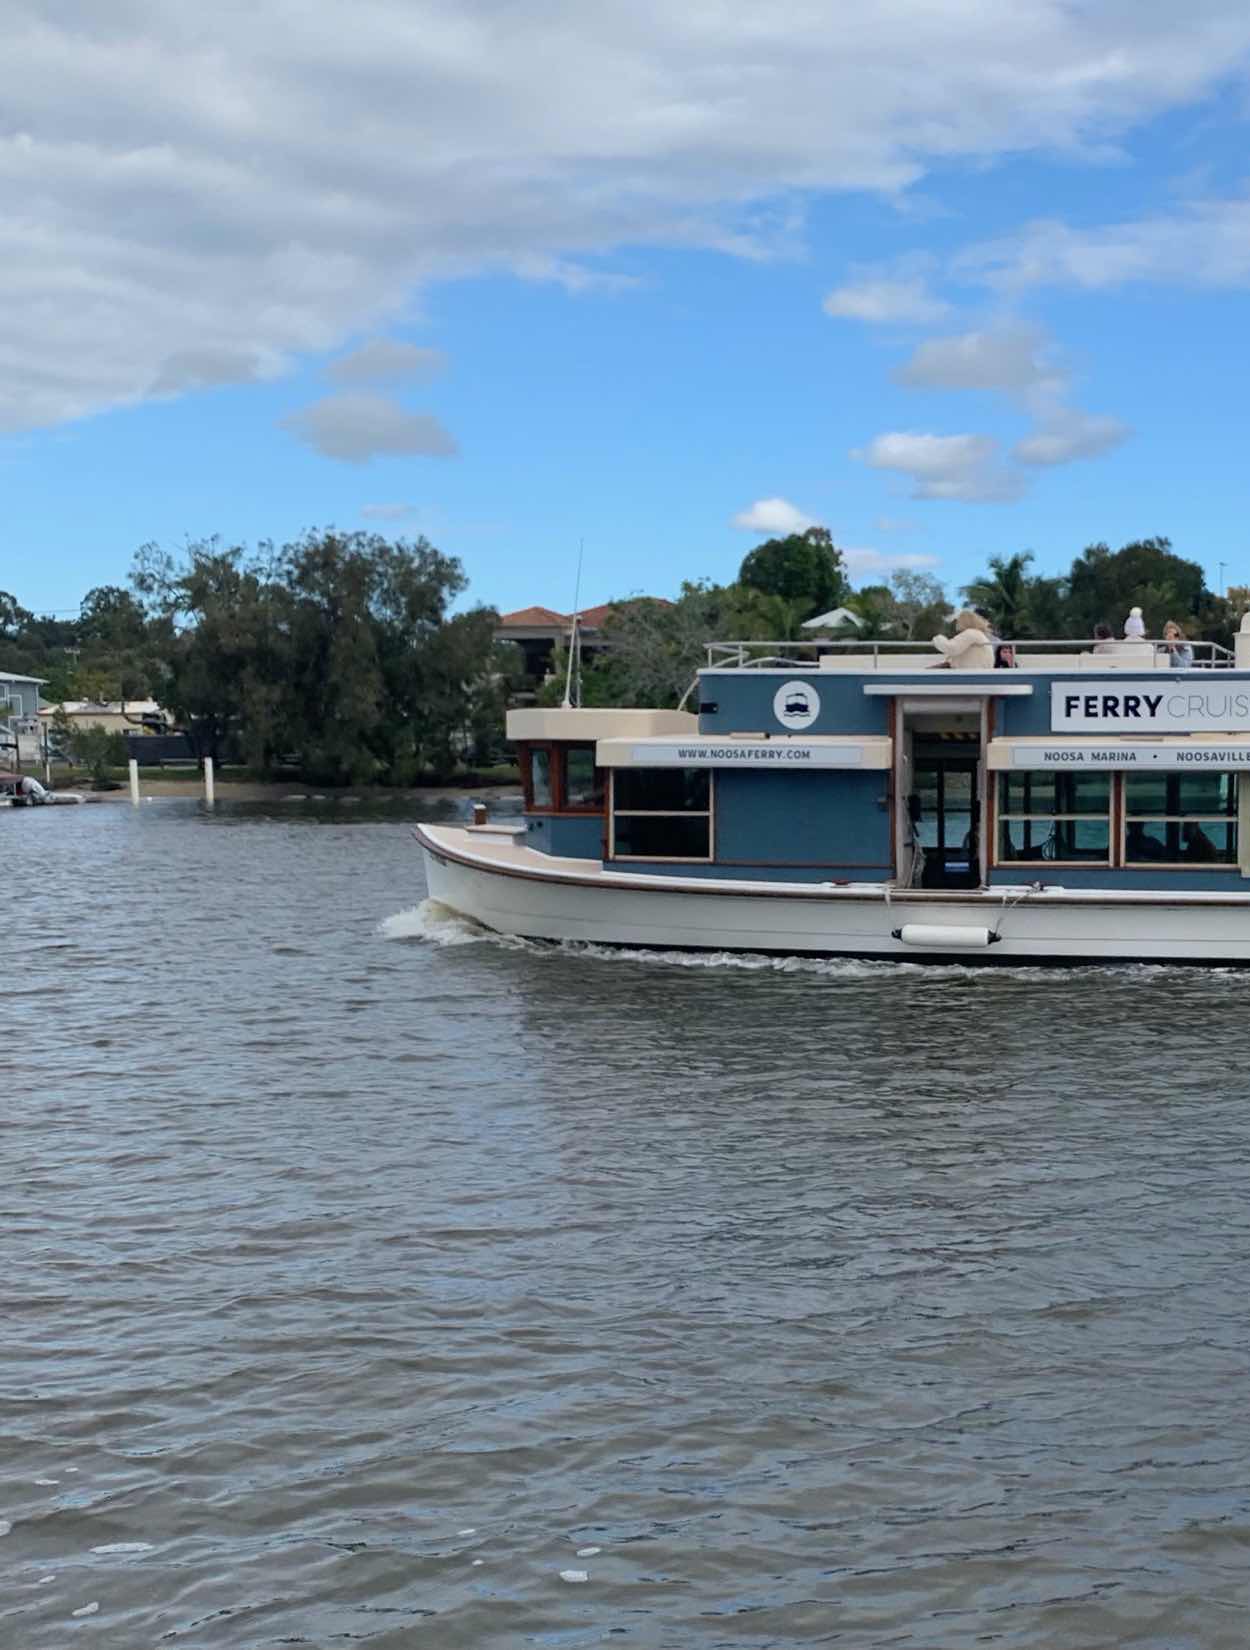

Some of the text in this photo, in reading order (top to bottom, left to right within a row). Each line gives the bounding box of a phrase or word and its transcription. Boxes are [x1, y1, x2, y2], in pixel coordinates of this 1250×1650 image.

[678, 749, 811, 760] WWW.NOOSAFERRY.COM
[1044, 751, 1084, 762] NOOSA
[1090, 751, 1137, 762] MARINA
